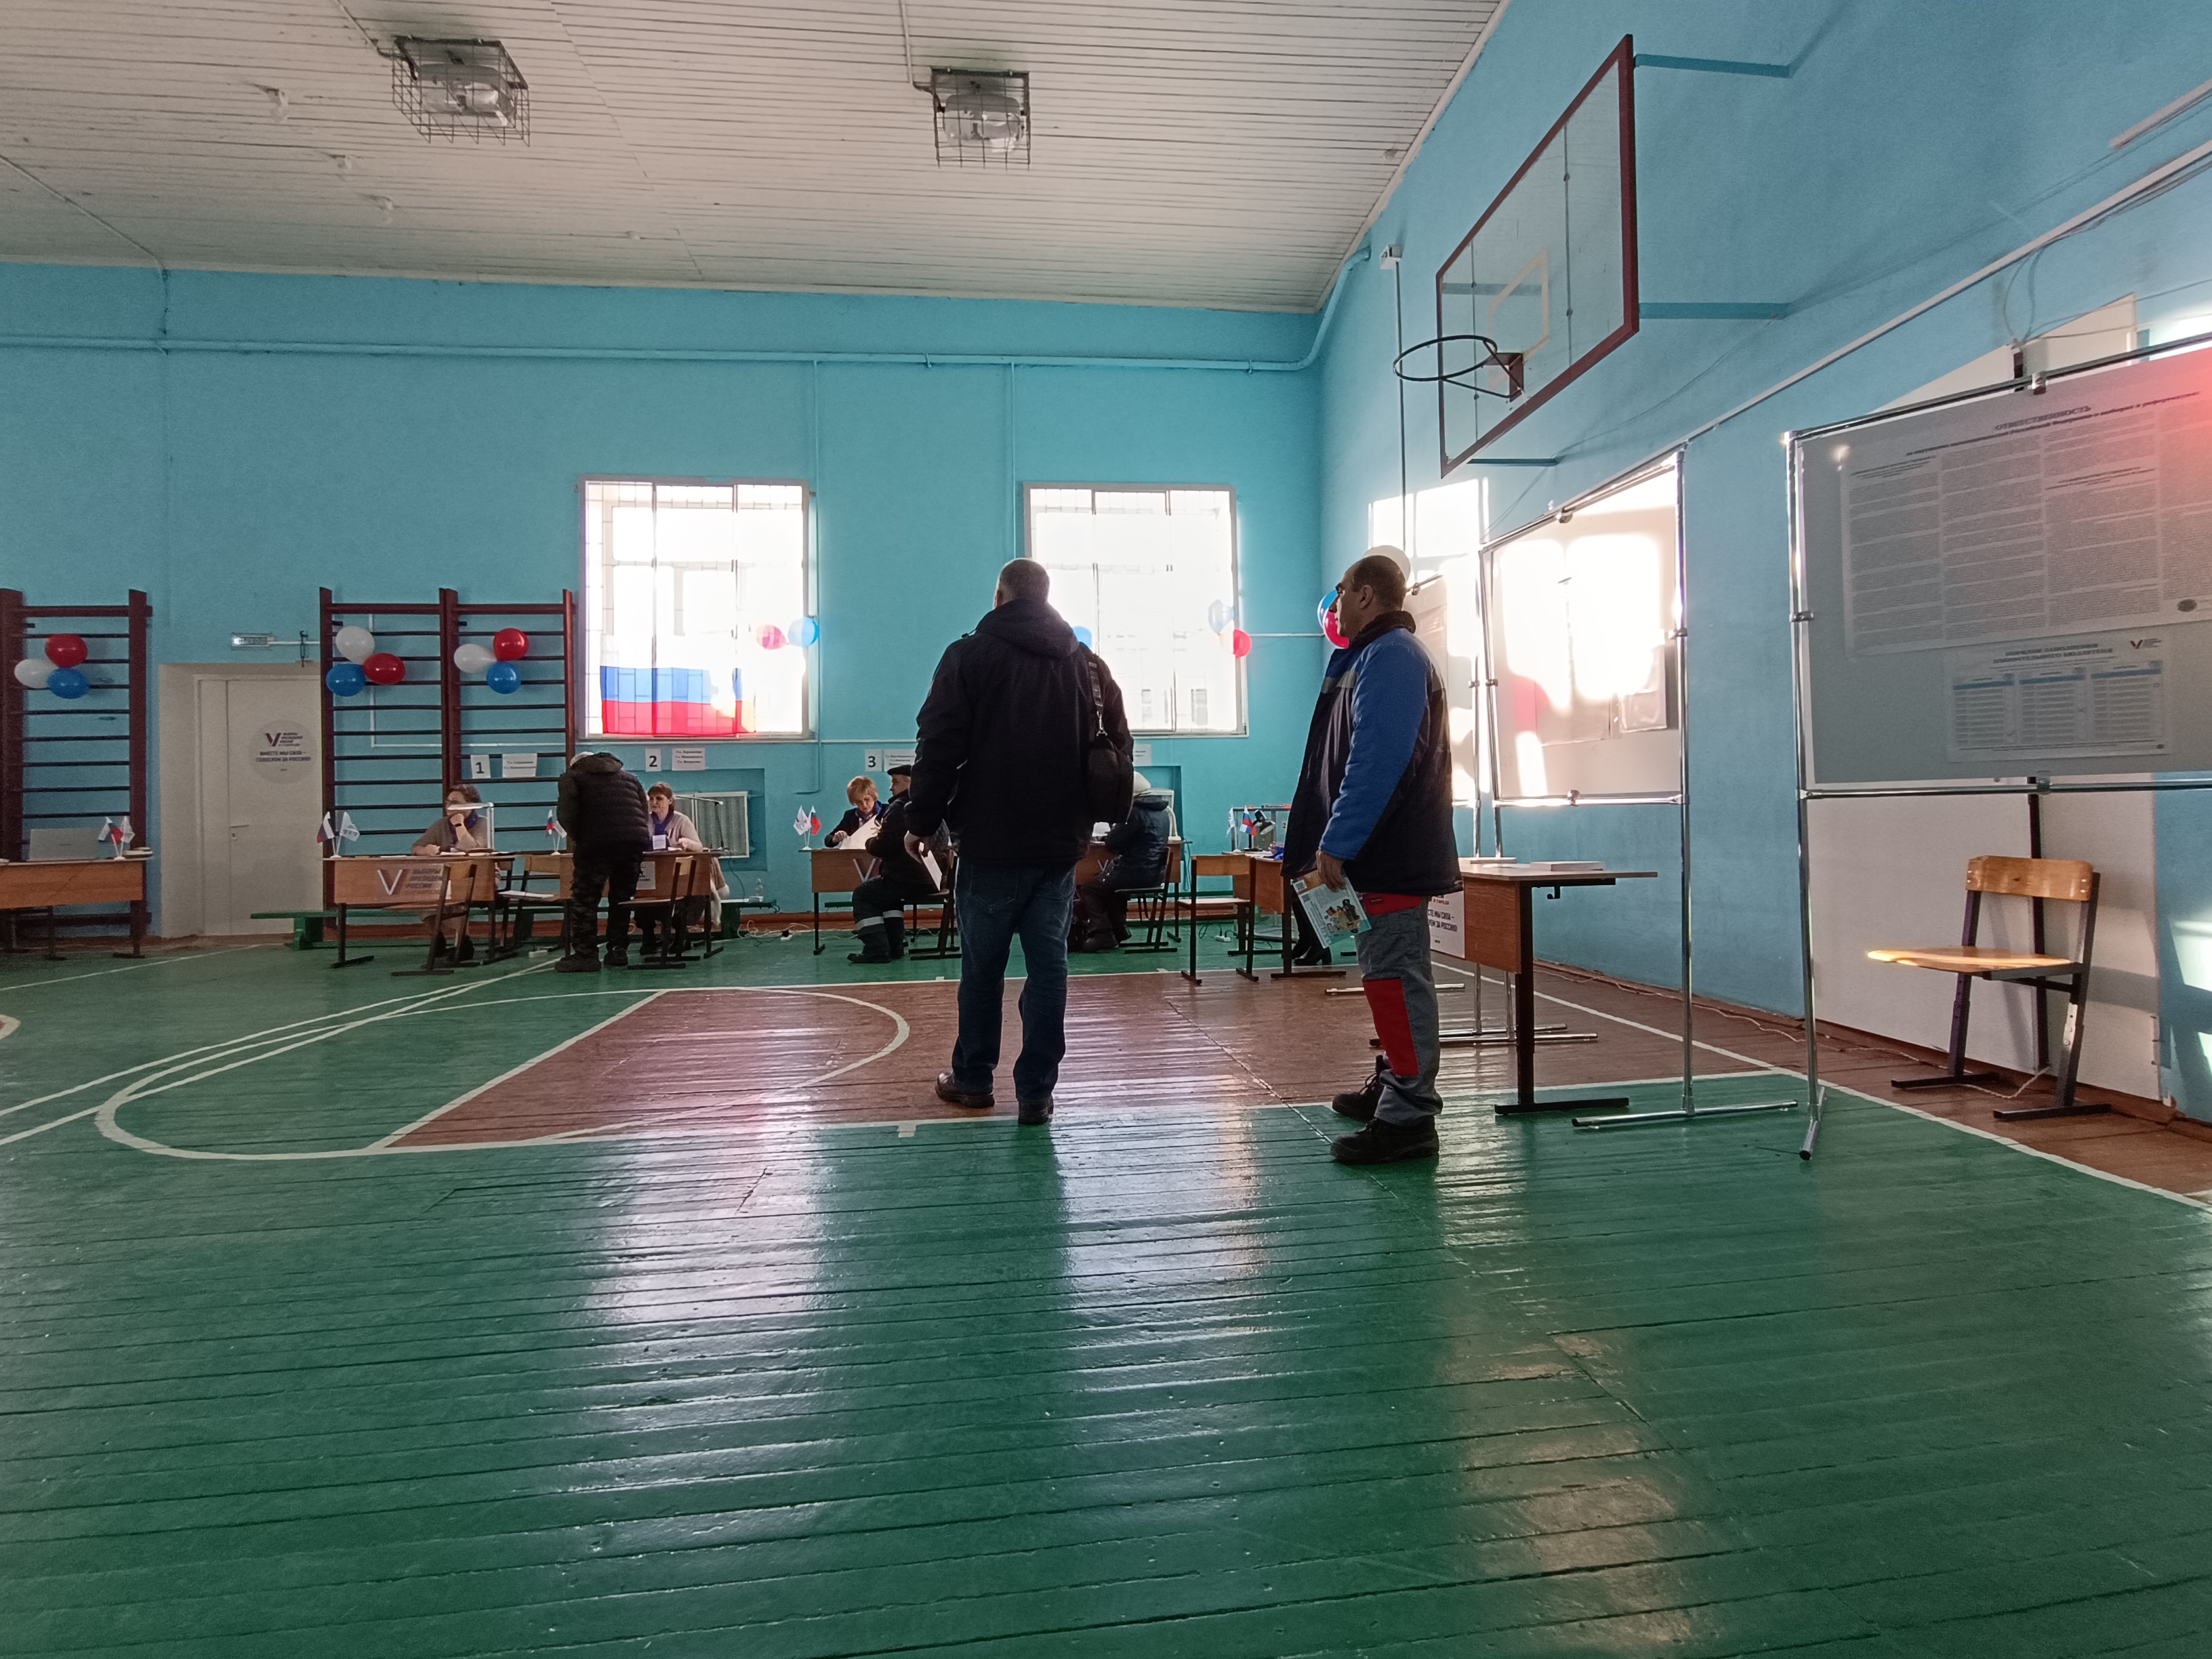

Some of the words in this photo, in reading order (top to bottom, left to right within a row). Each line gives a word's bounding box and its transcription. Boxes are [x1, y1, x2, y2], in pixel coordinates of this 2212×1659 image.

[649, 755, 658, 767] 2
[868, 756, 876, 768] 3
[476, 762, 485, 774] 1
